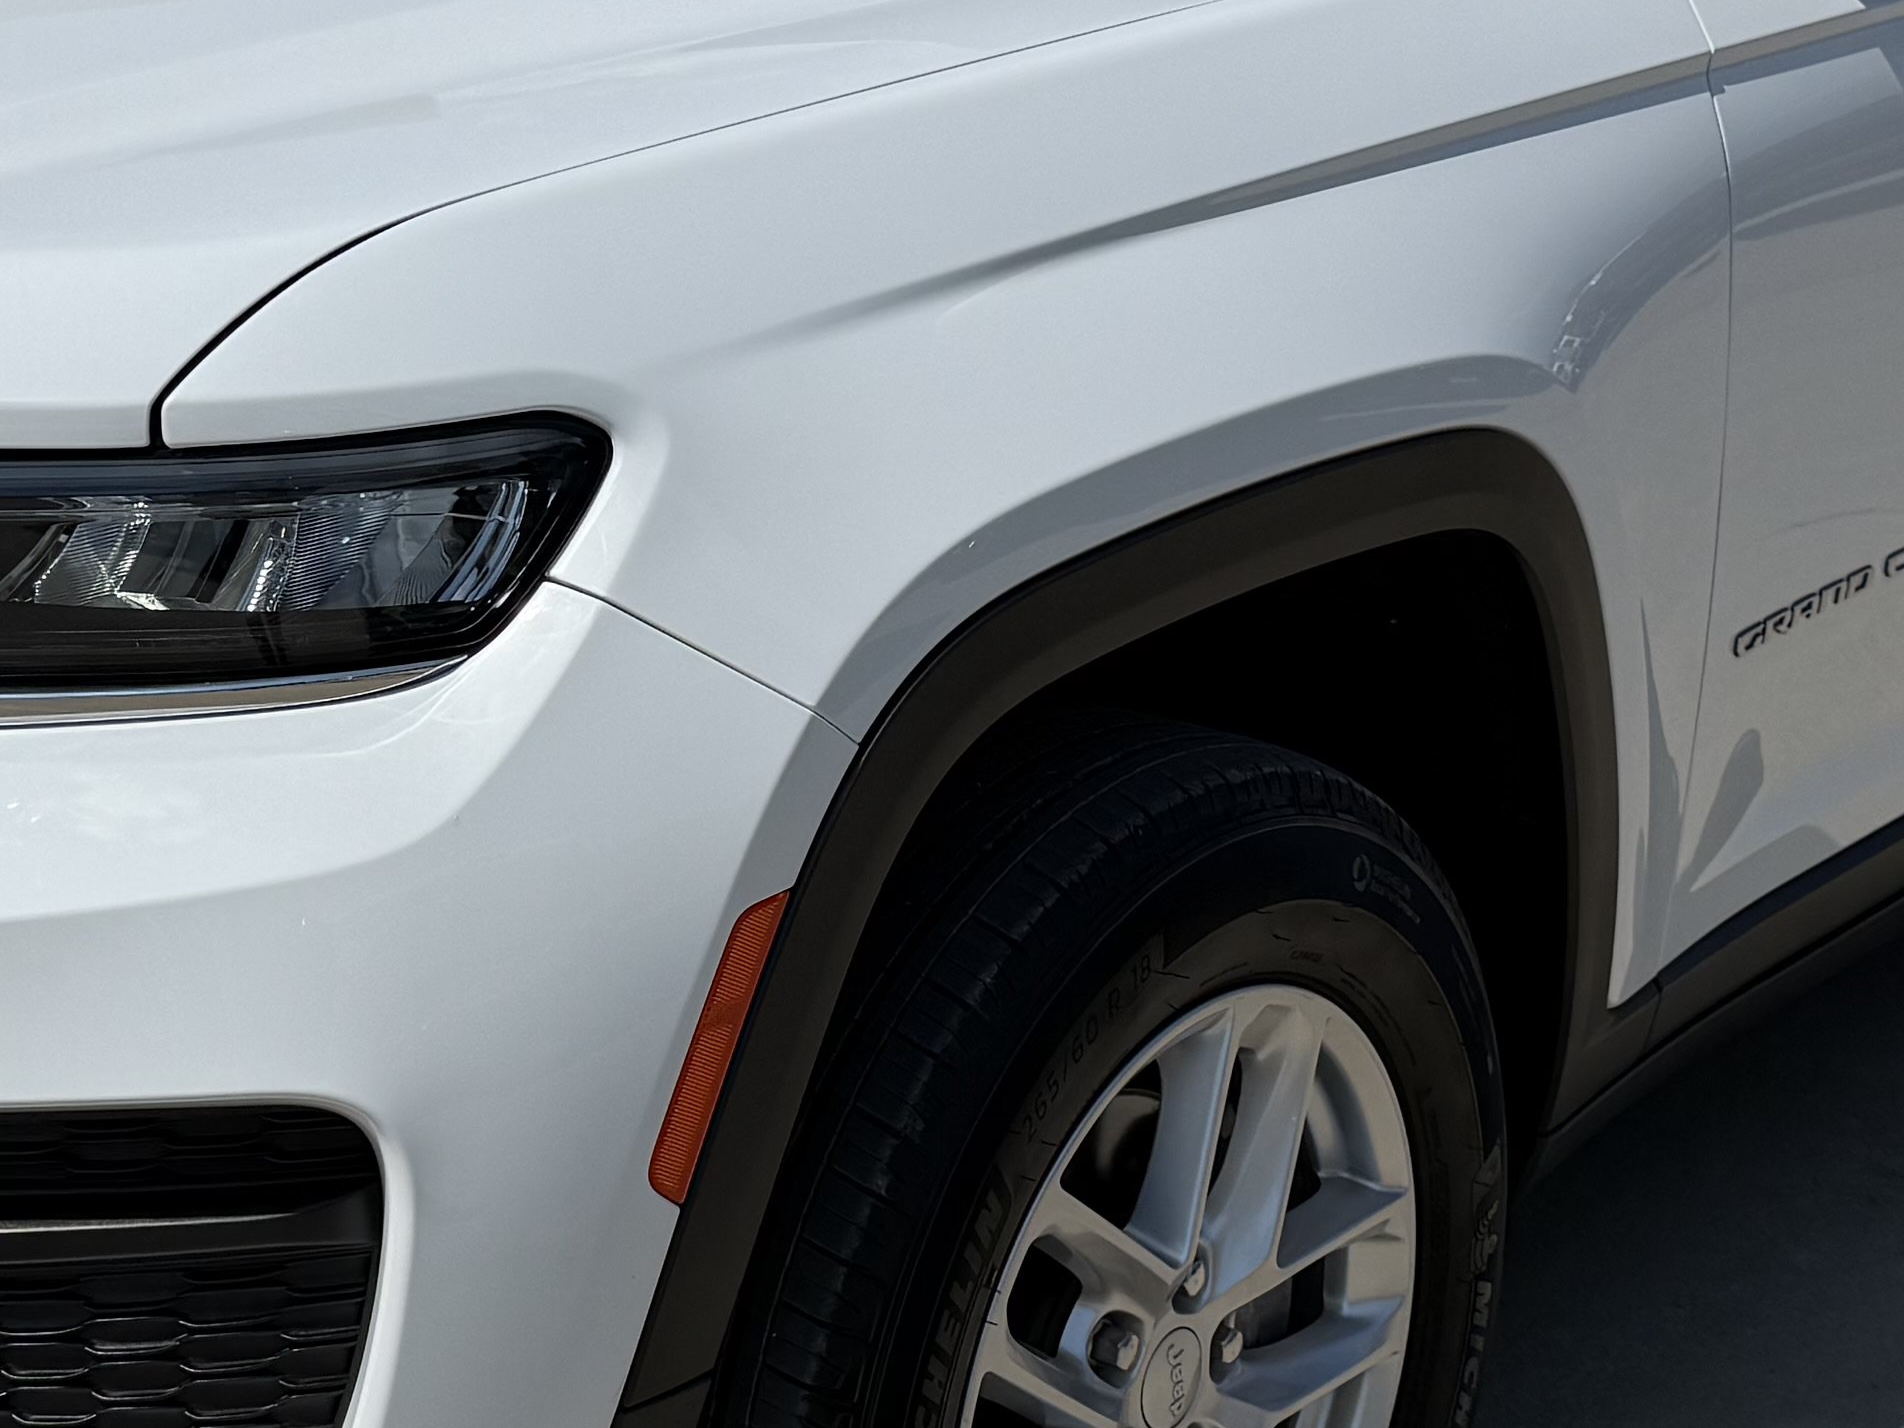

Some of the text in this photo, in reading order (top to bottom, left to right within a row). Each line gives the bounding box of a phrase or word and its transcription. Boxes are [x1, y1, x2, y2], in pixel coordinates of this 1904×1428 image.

[1732, 563, 1874, 658] GRAND
[1022, 954, 1151, 1143] 265/60 R 18
[1166, 1343, 1186, 1418] Jeep
